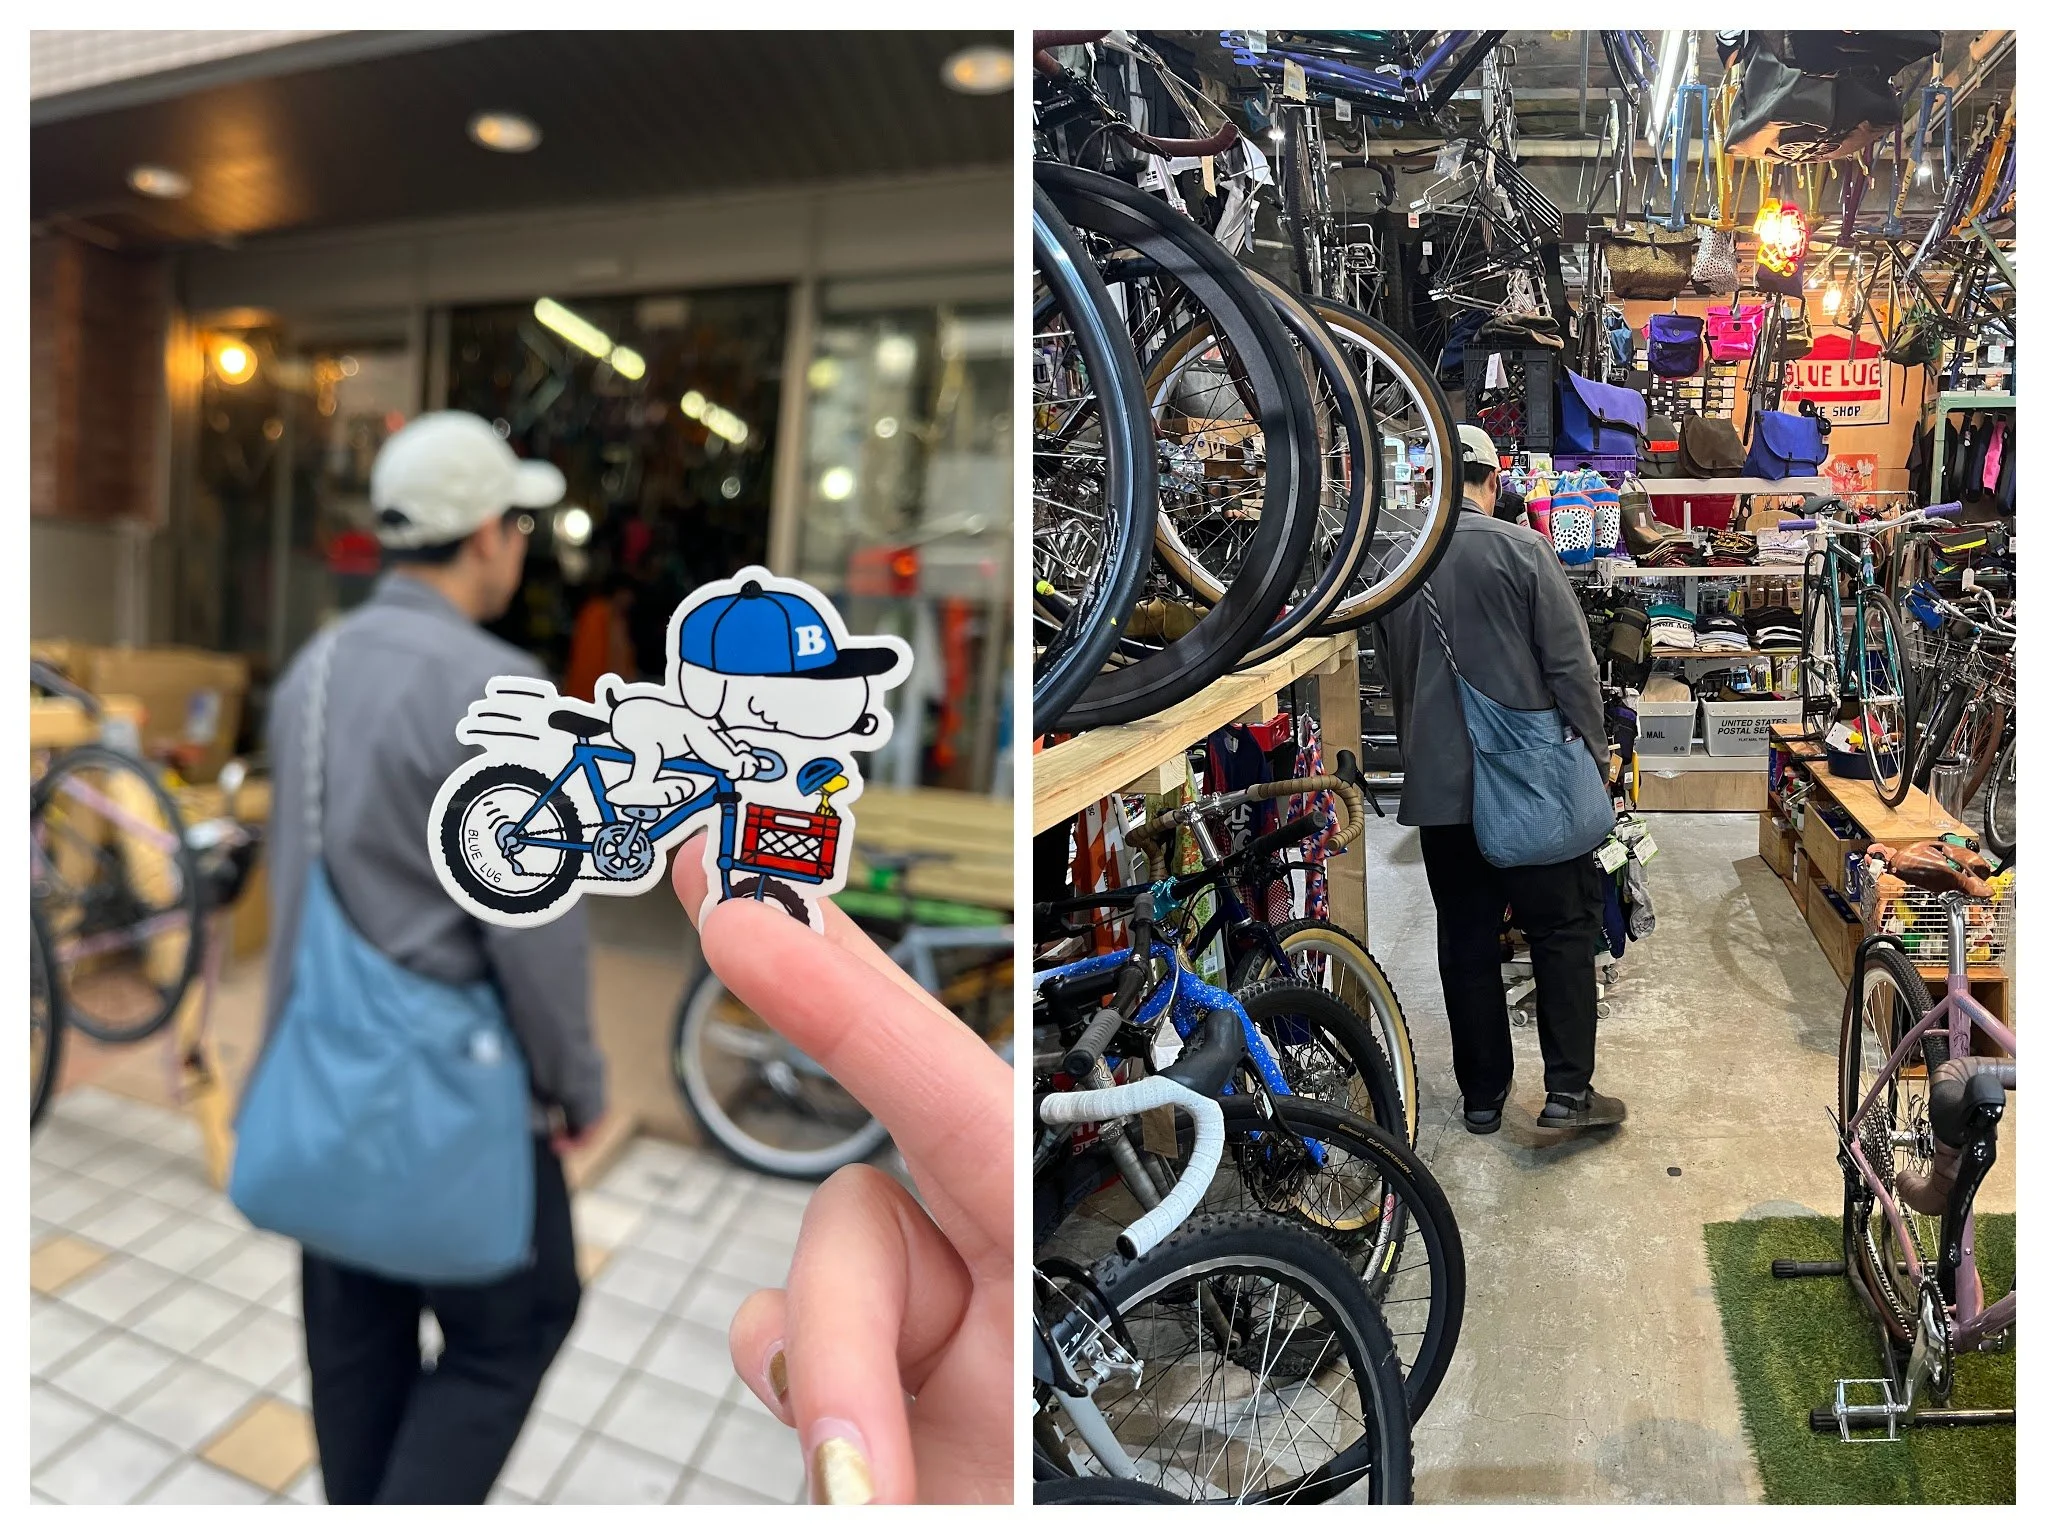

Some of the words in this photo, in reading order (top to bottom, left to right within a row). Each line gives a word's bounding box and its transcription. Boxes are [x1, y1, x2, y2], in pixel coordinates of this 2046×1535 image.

[1841, 363, 1881, 387] LUG
[1833, 405, 1861, 417] SHOP
[794, 624, 827, 657] B
[1717, 727, 1751, 735] POSTAL
[1721, 719, 1753, 727] UNITED
[1646, 731, 1666, 739] MAIL
[468, 829, 483, 861] BLUE
[1367, 1138, 1412, 1174] GATORSKIN
